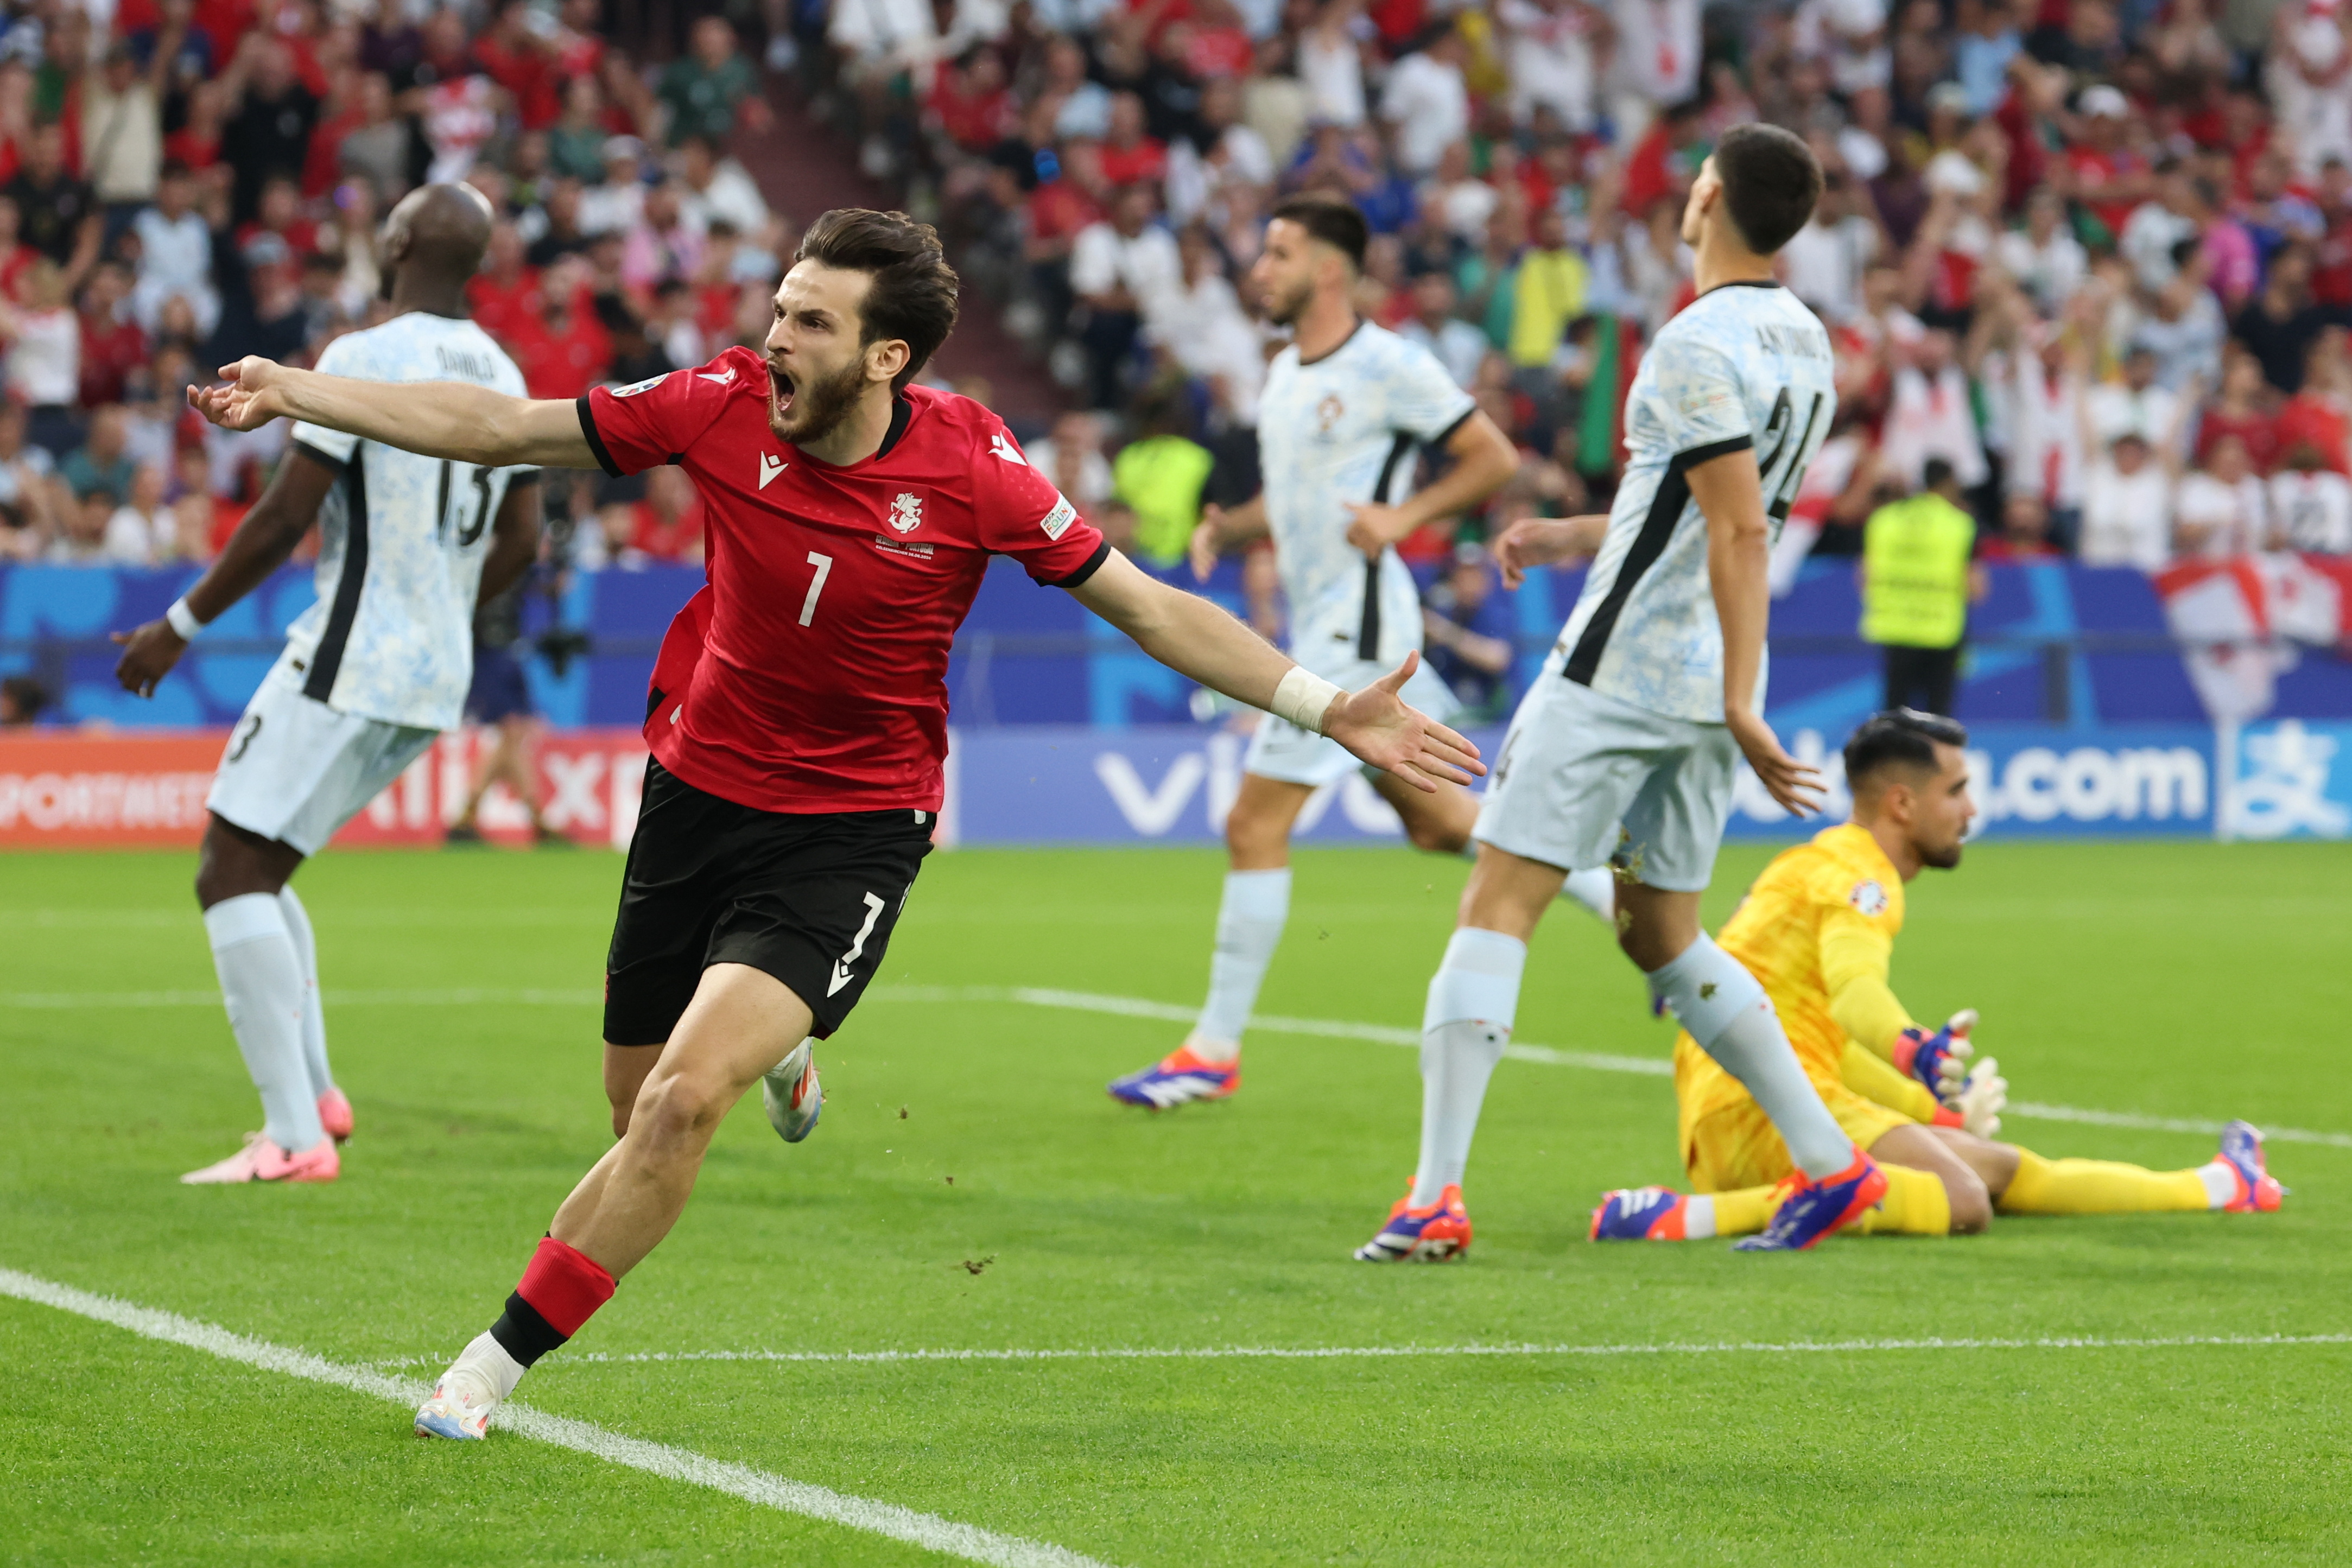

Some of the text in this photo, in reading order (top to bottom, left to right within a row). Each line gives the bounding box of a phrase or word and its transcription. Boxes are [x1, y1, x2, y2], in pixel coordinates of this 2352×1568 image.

[1043, 512, 1055, 526] UEFA
[875, 544, 932, 560] GELSENKIRCHEN 26.06.2024
[798, 551, 833, 627] 7
[841, 891, 885, 964] 7
